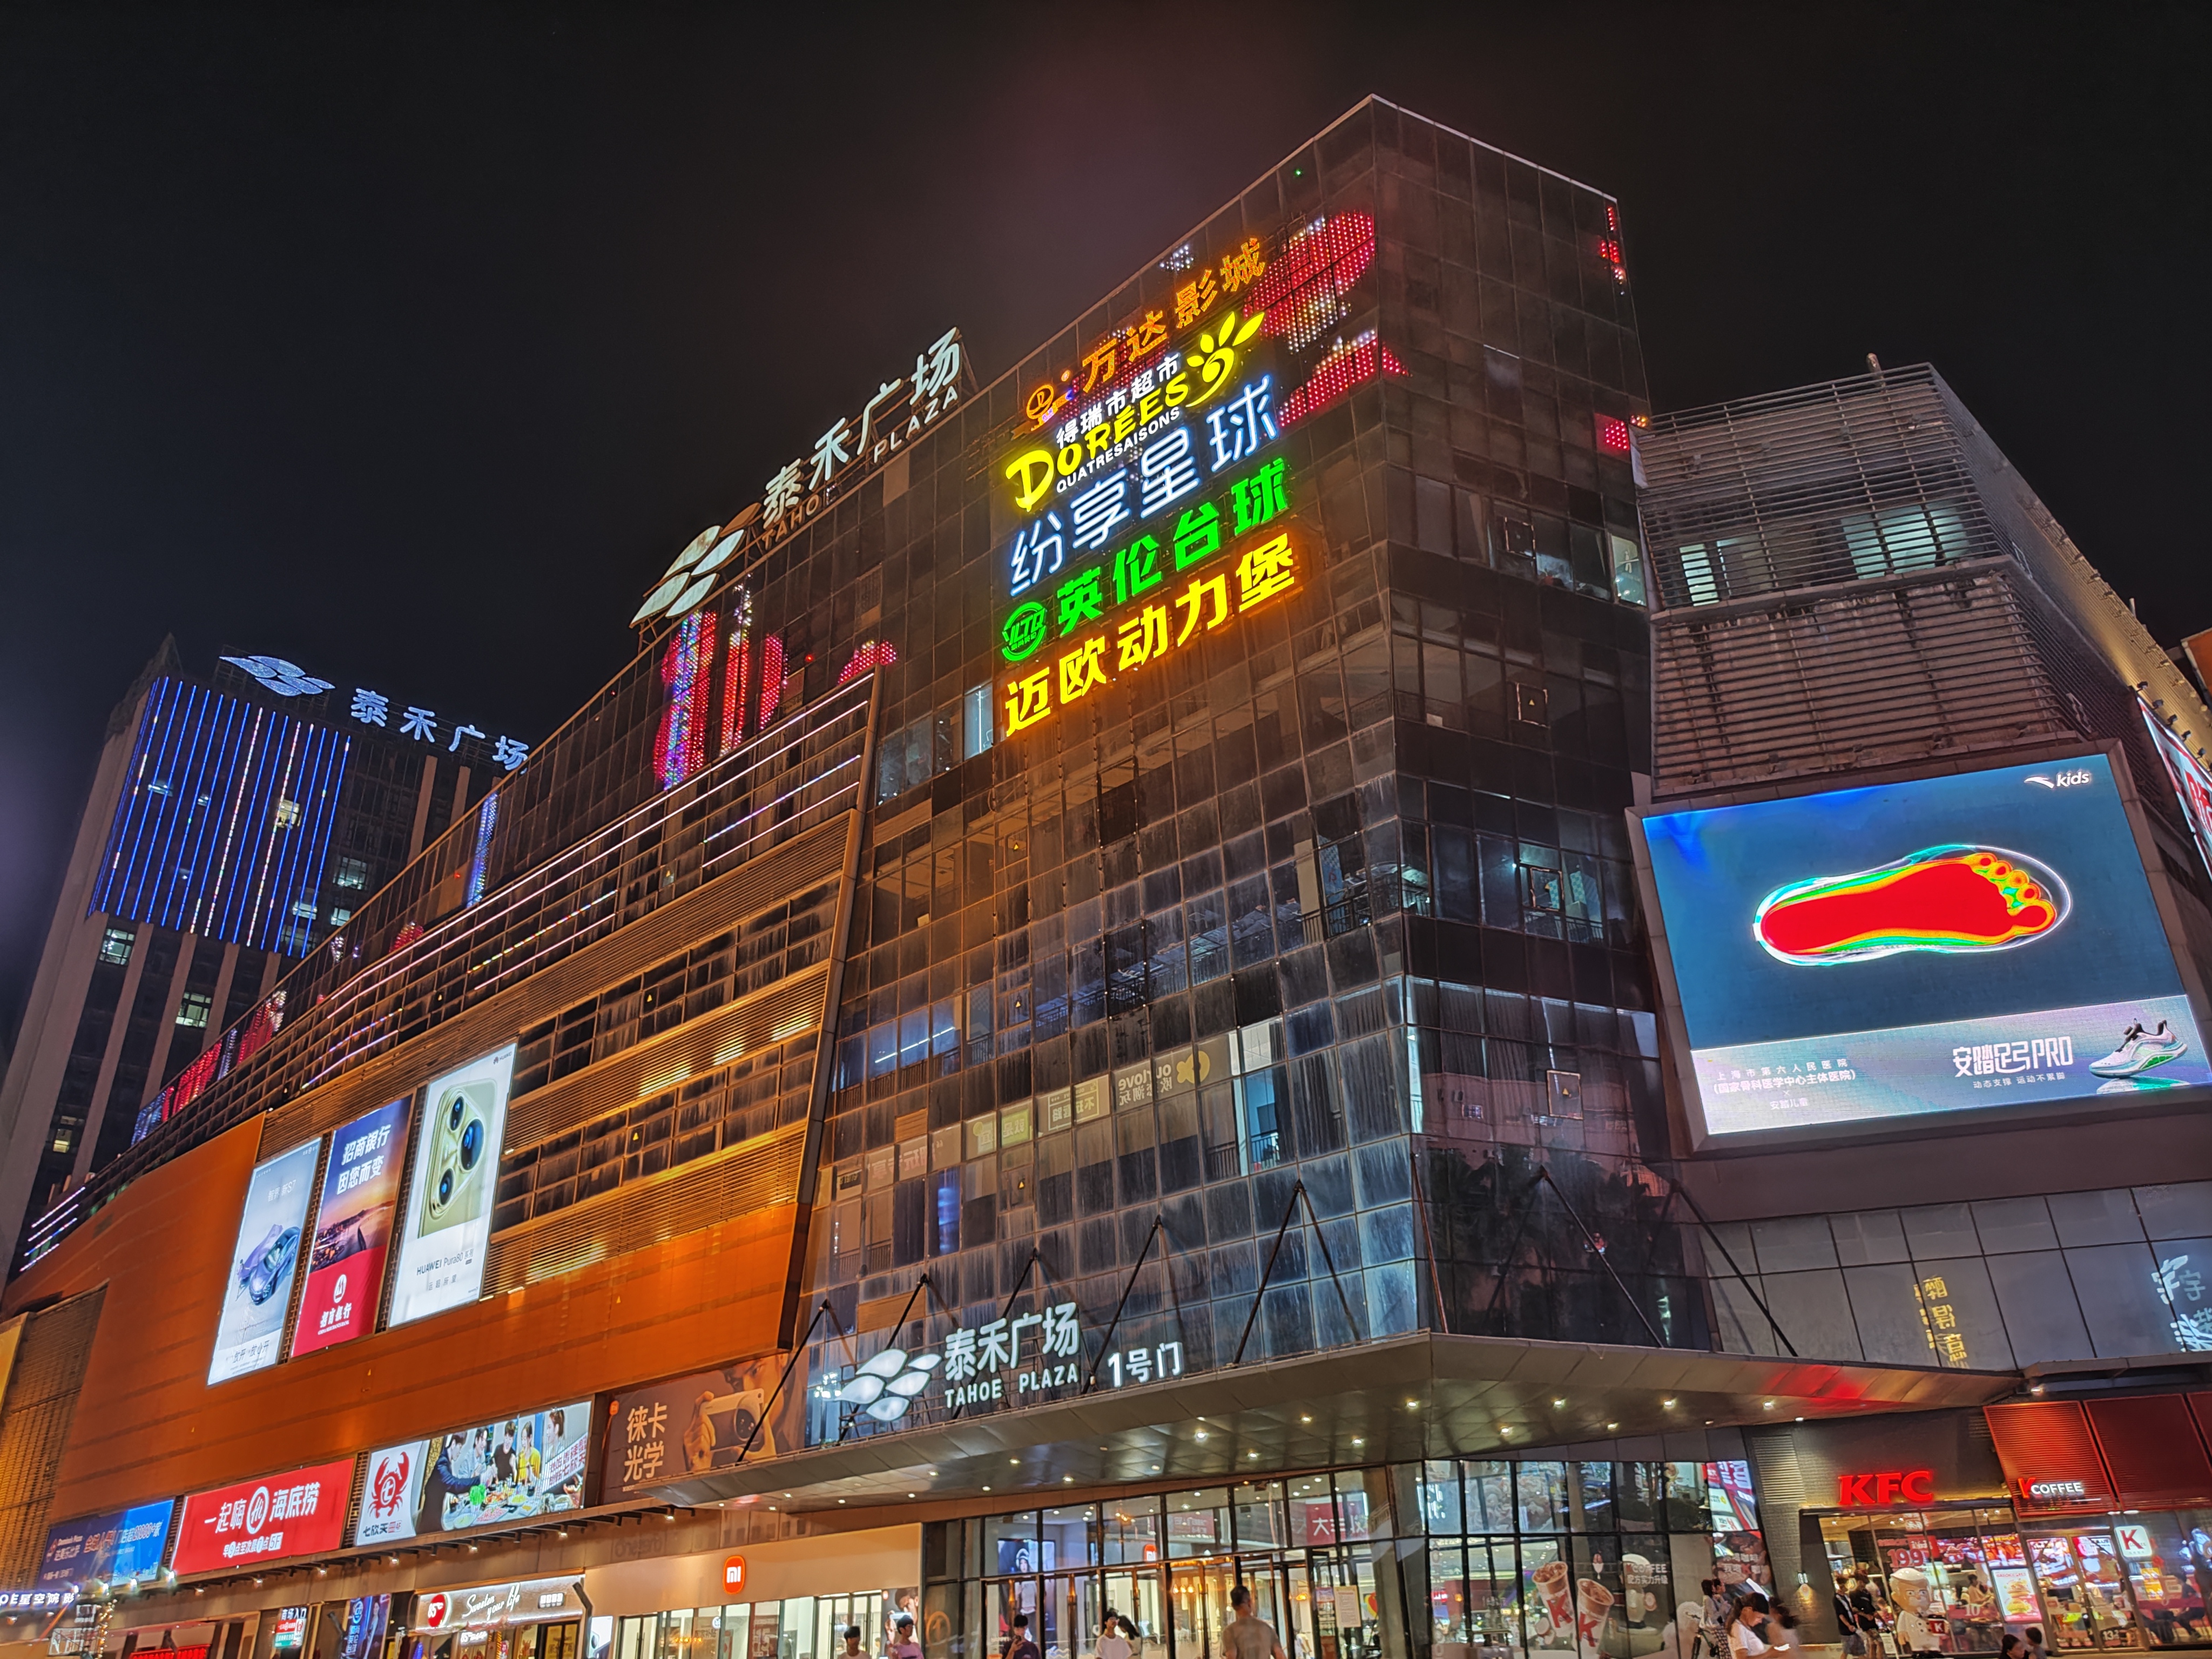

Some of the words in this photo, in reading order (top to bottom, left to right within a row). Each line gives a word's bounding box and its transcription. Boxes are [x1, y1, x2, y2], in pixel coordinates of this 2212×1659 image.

[1082, 238, 1265, 393] 万达影城
[1056, 353, 1180, 449] 得瑞市超市
[763, 327, 960, 529] 泰禾广场
[874, 386, 957, 463] PLAZA
[1056, 407, 1180, 493] QUATRESAISONS
[1011, 376, 1277, 596] 纷享星球
[1057, 457, 1287, 636] 英伦台球
[1006, 532, 1294, 736] 迈欧动力堡
[351, 688, 529, 771] 泰禾广场
[2056, 771, 2089, 787] kids
[1717, 1058, 1848, 1081] 上海市第六人民医院
[1973, 1078, 2012, 1089] 动态支撑
[2016, 1072, 2066, 1084] 运动不累脚
[1770, 1097, 1808, 1110] 安踏儿童
[341, 1124, 392, 1165] 招商银行
[336, 1155, 385, 1195] 因您而变
[417, 1259, 442, 1276] HUAWEI
[945, 1302, 1080, 1381] 泰禾广场
[1108, 1341, 1184, 1387] 1号门
[945, 1379, 1003, 1408] TAHOE
[1019, 1363, 1078, 1392] PLAZA
[626, 1402, 667, 1443] 徕卡
[623, 1440, 664, 1482] 光学
[205, 1499, 247, 1533] 一起嗨
[269, 1482, 320, 1522] 海底捞
[1838, 1471, 1933, 1506] KFC
[363, 1523, 388, 1537] 七欣天
[2120, 1529, 2144, 1550] K
[1628, 1575, 1669, 1584] 配方实力升级
[462, 1594, 495, 1618] Sweeten
[487, 1604, 504, 1620] your
[507, 1582, 521, 1611] life
